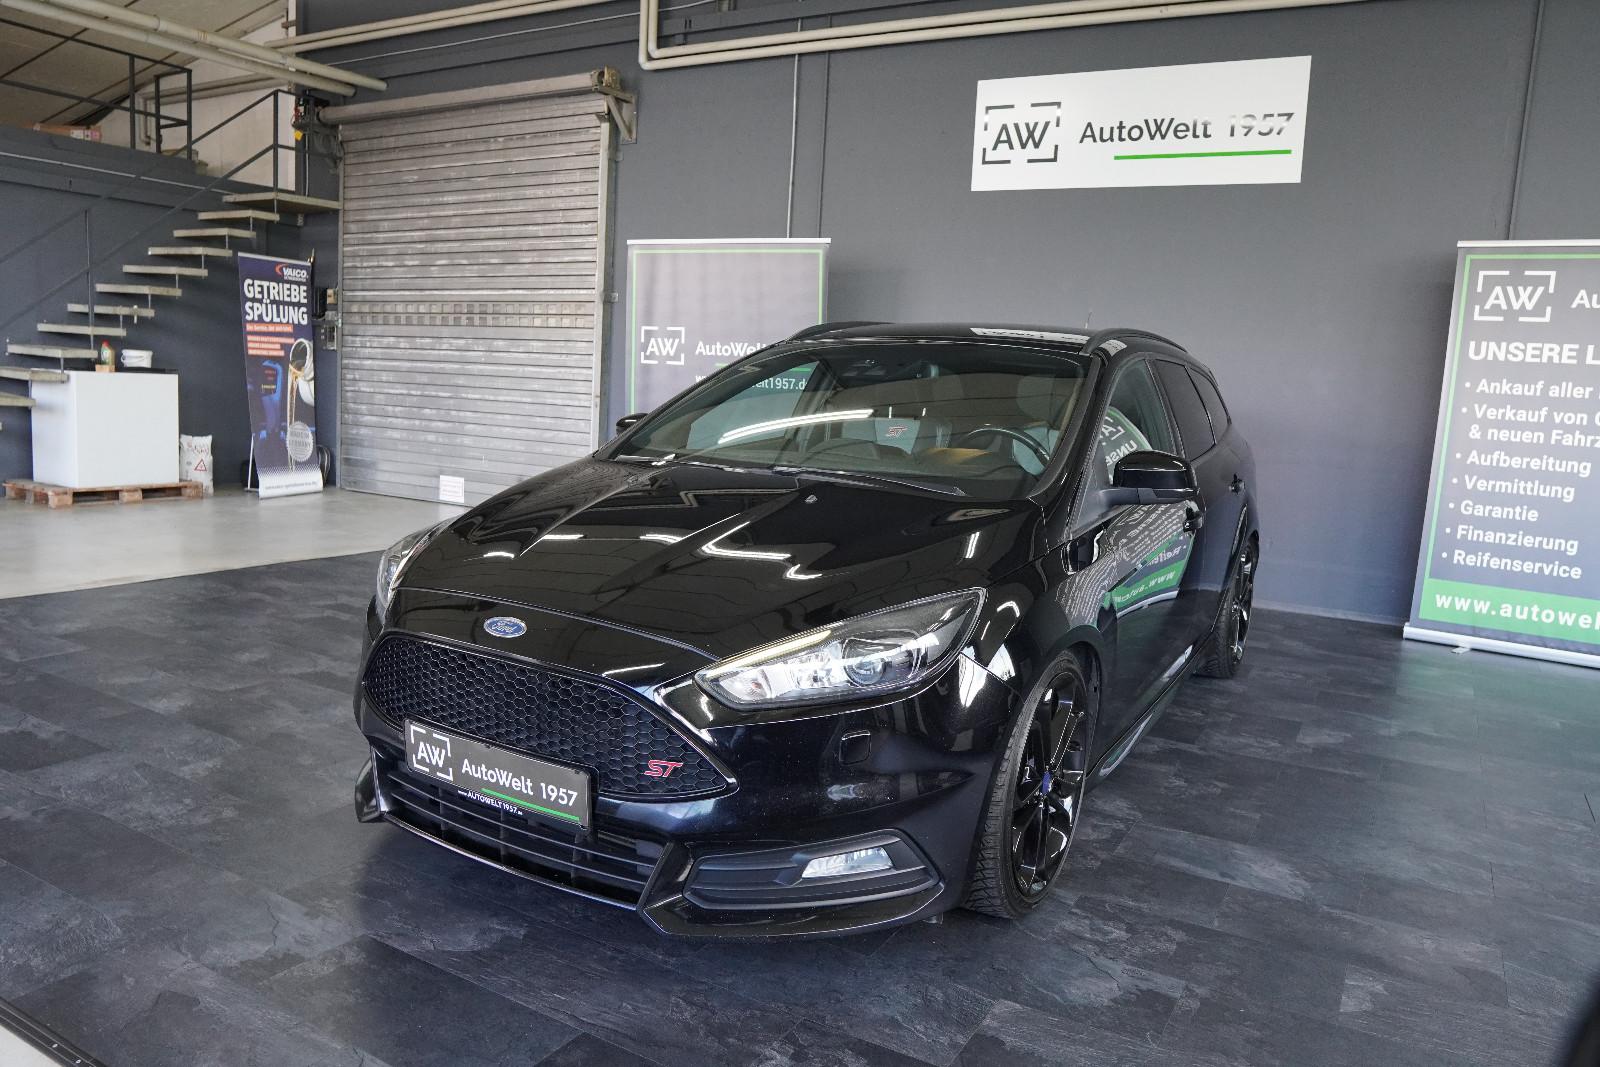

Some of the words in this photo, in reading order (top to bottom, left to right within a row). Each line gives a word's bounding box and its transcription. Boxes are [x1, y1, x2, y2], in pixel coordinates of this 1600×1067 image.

[992, 120, 1051, 151] AW
[1079, 116, 1212, 144] AutoWelt
[1228, 112, 1295, 137] 1957
[243, 278, 308, 304] GETRIEBE
[1483, 285, 1545, 311] AW
[244, 298, 308, 325] SPÜLUNG
[645, 337, 680, 357] AW
[1468, 340, 1580, 364] UNSERE
[1476, 378, 1545, 396] Ankauf
[1548, 381, 1594, 399] aller
[1474, 403, 1549, 423] Verkauf
[1553, 411, 1588, 425] von
[1469, 424, 1482, 440] &
[1487, 428, 1545, 444] neuen
[1466, 449, 1592, 478] Aufbereitung
[1464, 474, 1576, 503] Vermittlung
[1460, 499, 1539, 522] Garantie
[1457, 525, 1579, 556] Finanzierung
[1453, 549, 1583, 580] Reifenservice
[417, 741, 446, 768] AW
[644, 759, 684, 777] ST
[461, 758, 534, 796] AutoWelt
[540, 782, 578, 807] 1957
